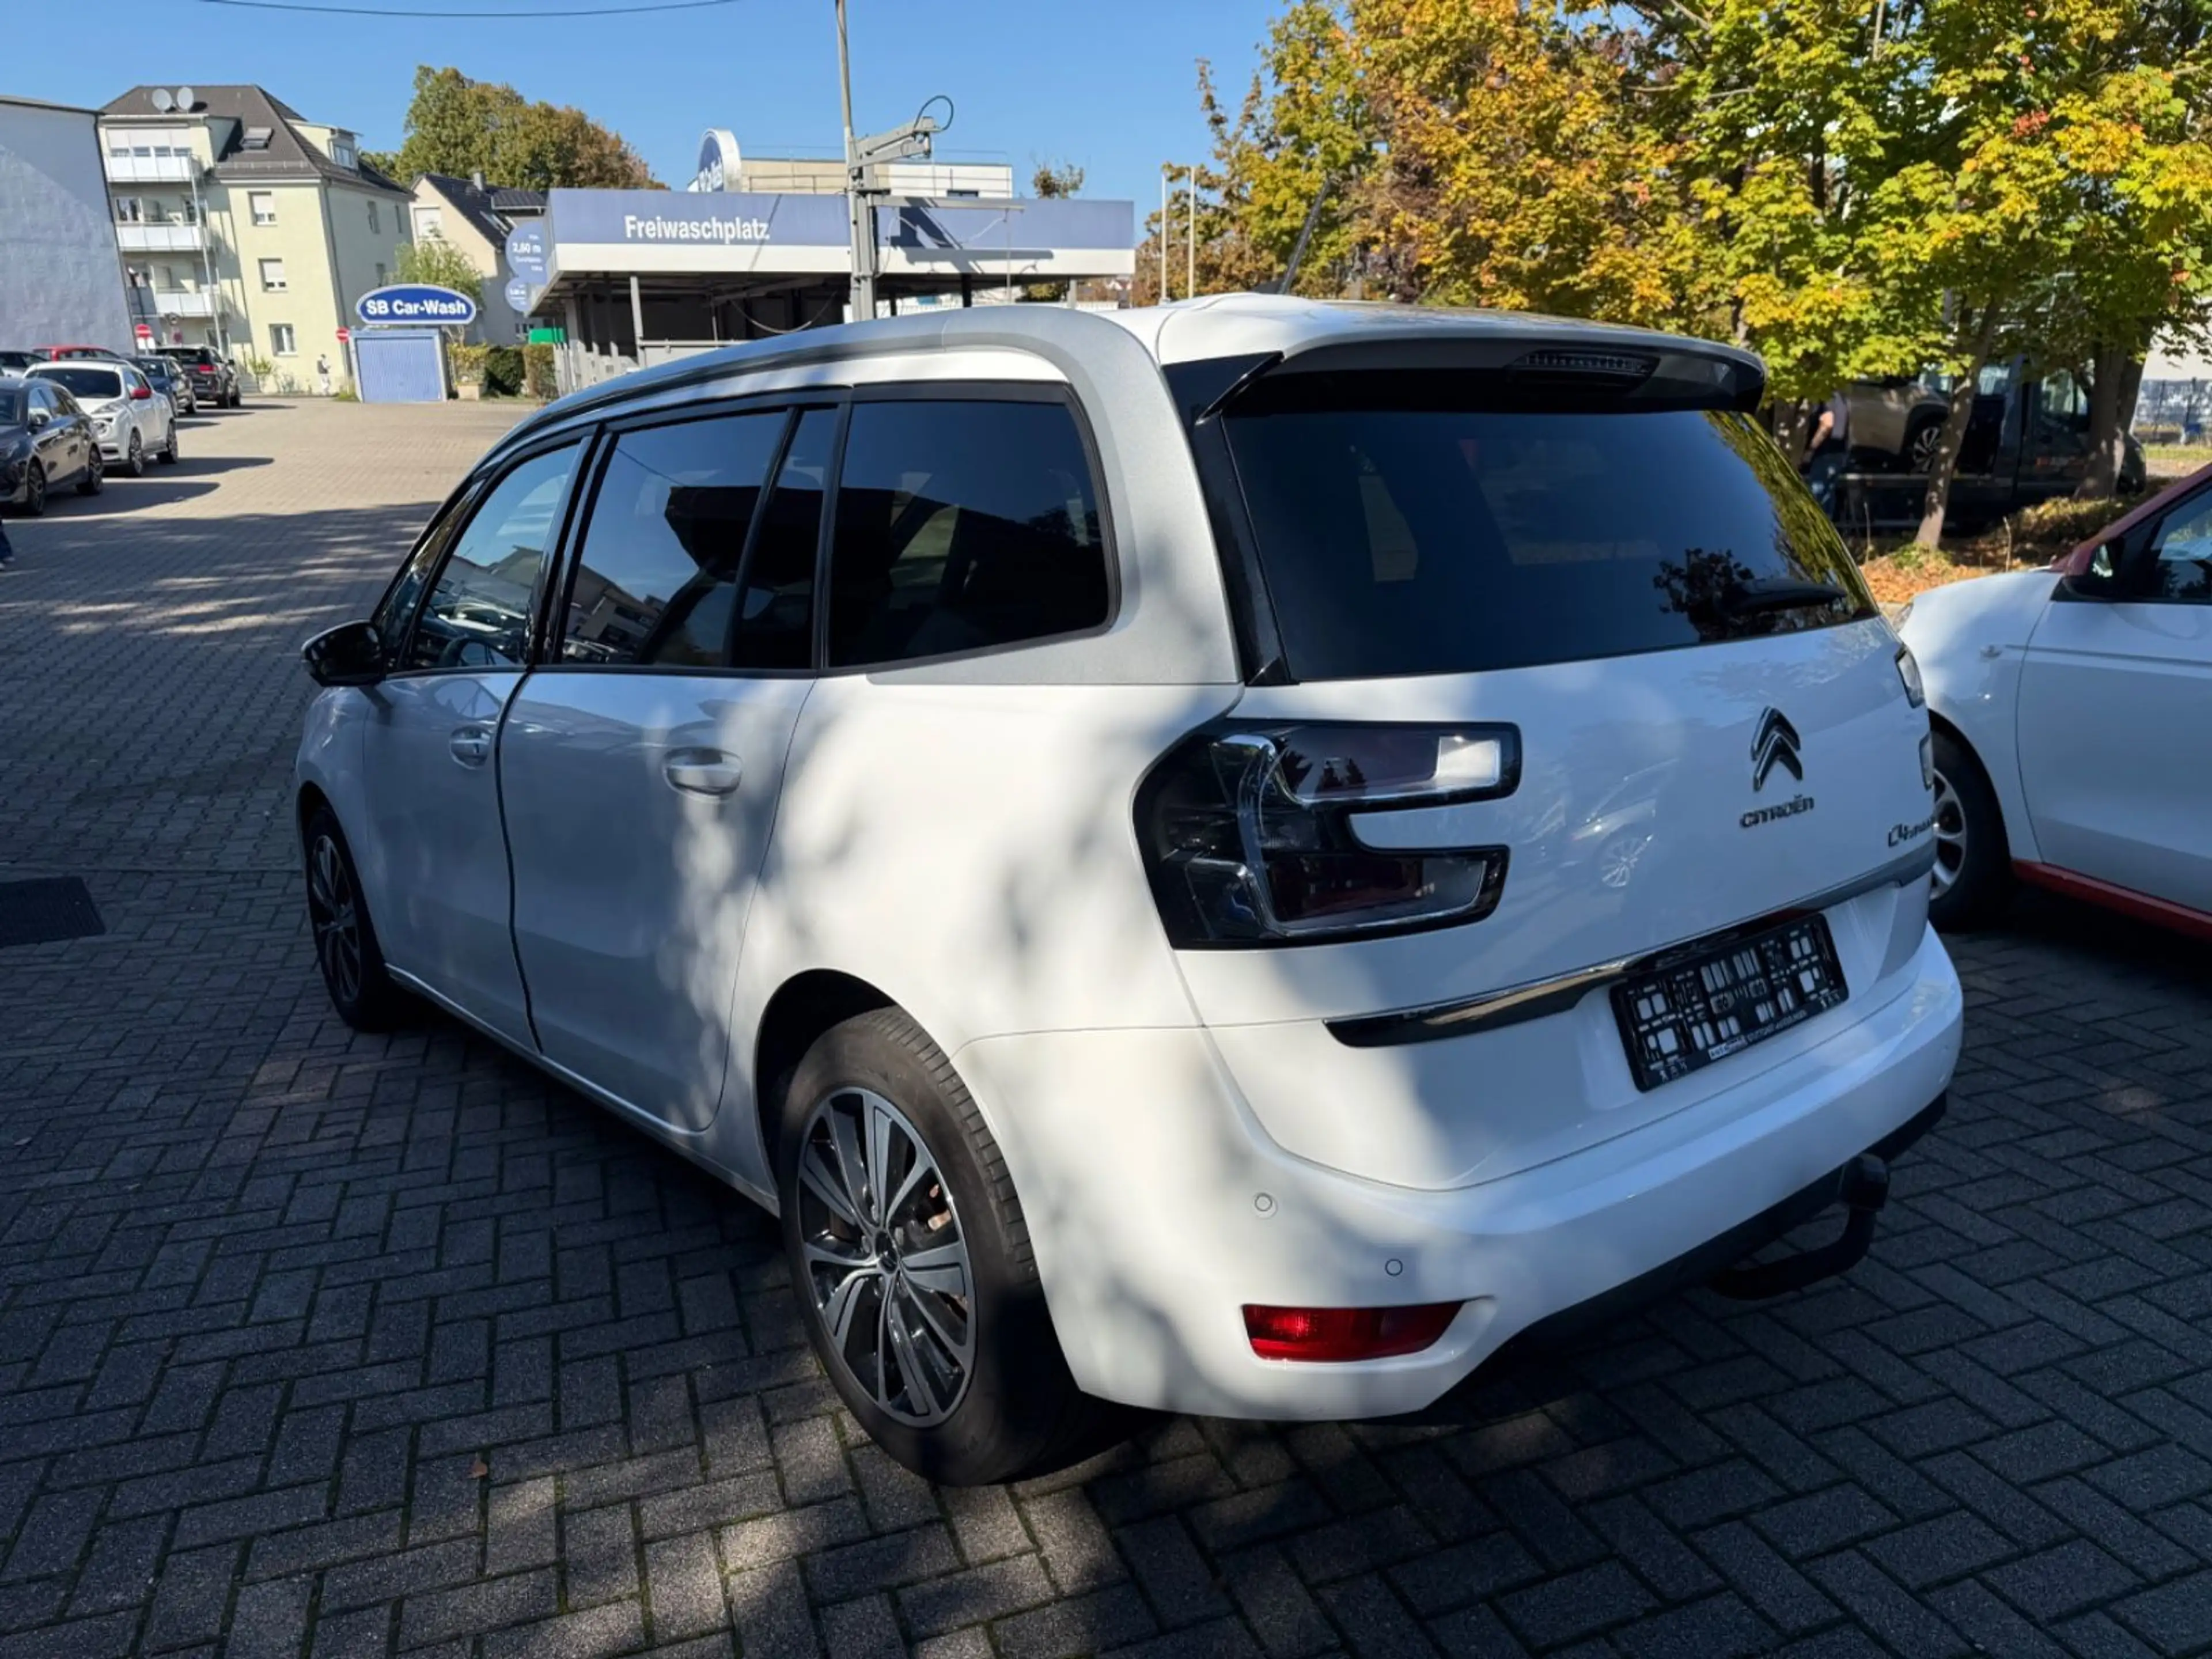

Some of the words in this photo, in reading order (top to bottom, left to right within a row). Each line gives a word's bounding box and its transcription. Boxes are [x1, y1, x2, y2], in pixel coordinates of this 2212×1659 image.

[624, 215, 770, 244] Freiwaschplatz
[366, 300, 389, 315] SB
[392, 300, 467, 315] Car-Wash
